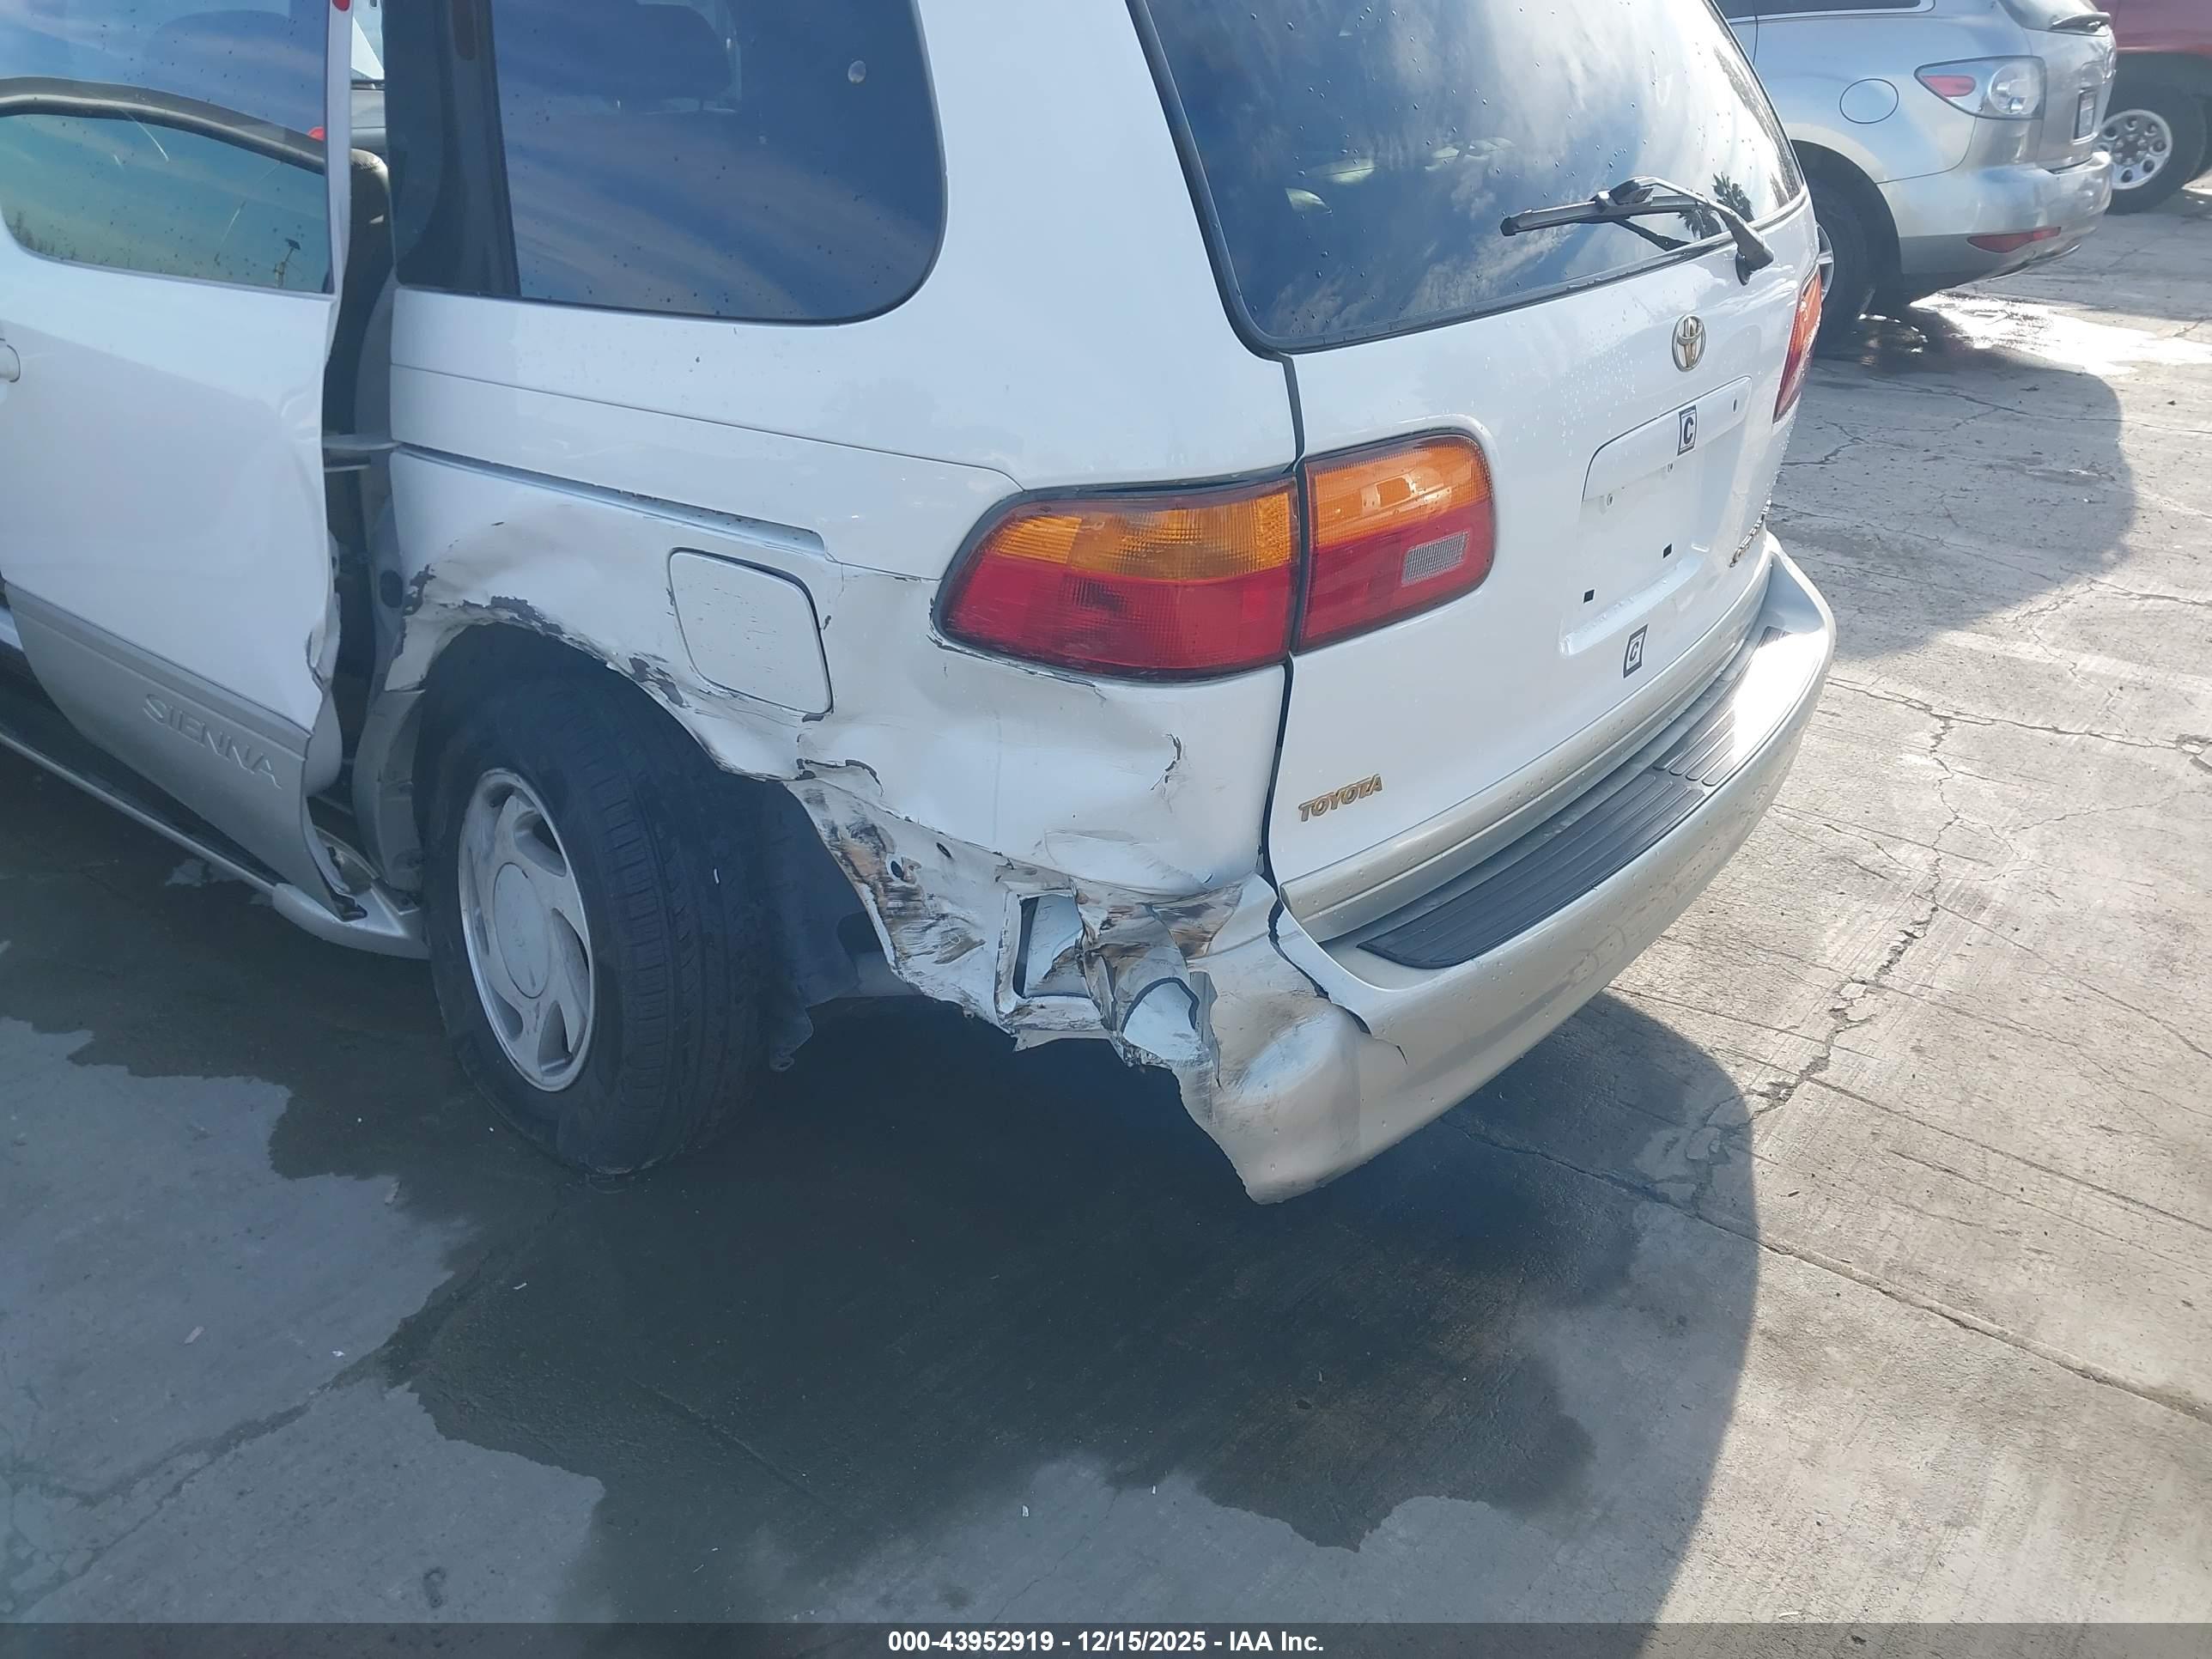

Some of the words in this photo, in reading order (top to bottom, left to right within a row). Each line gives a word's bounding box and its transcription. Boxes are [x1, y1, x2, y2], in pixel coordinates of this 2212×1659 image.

[1683, 416, 1694, 445] C
[1629, 641, 1640, 662] C
[143, 693, 283, 790] SIENNA
[1297, 773, 1382, 823] TOYOTA
